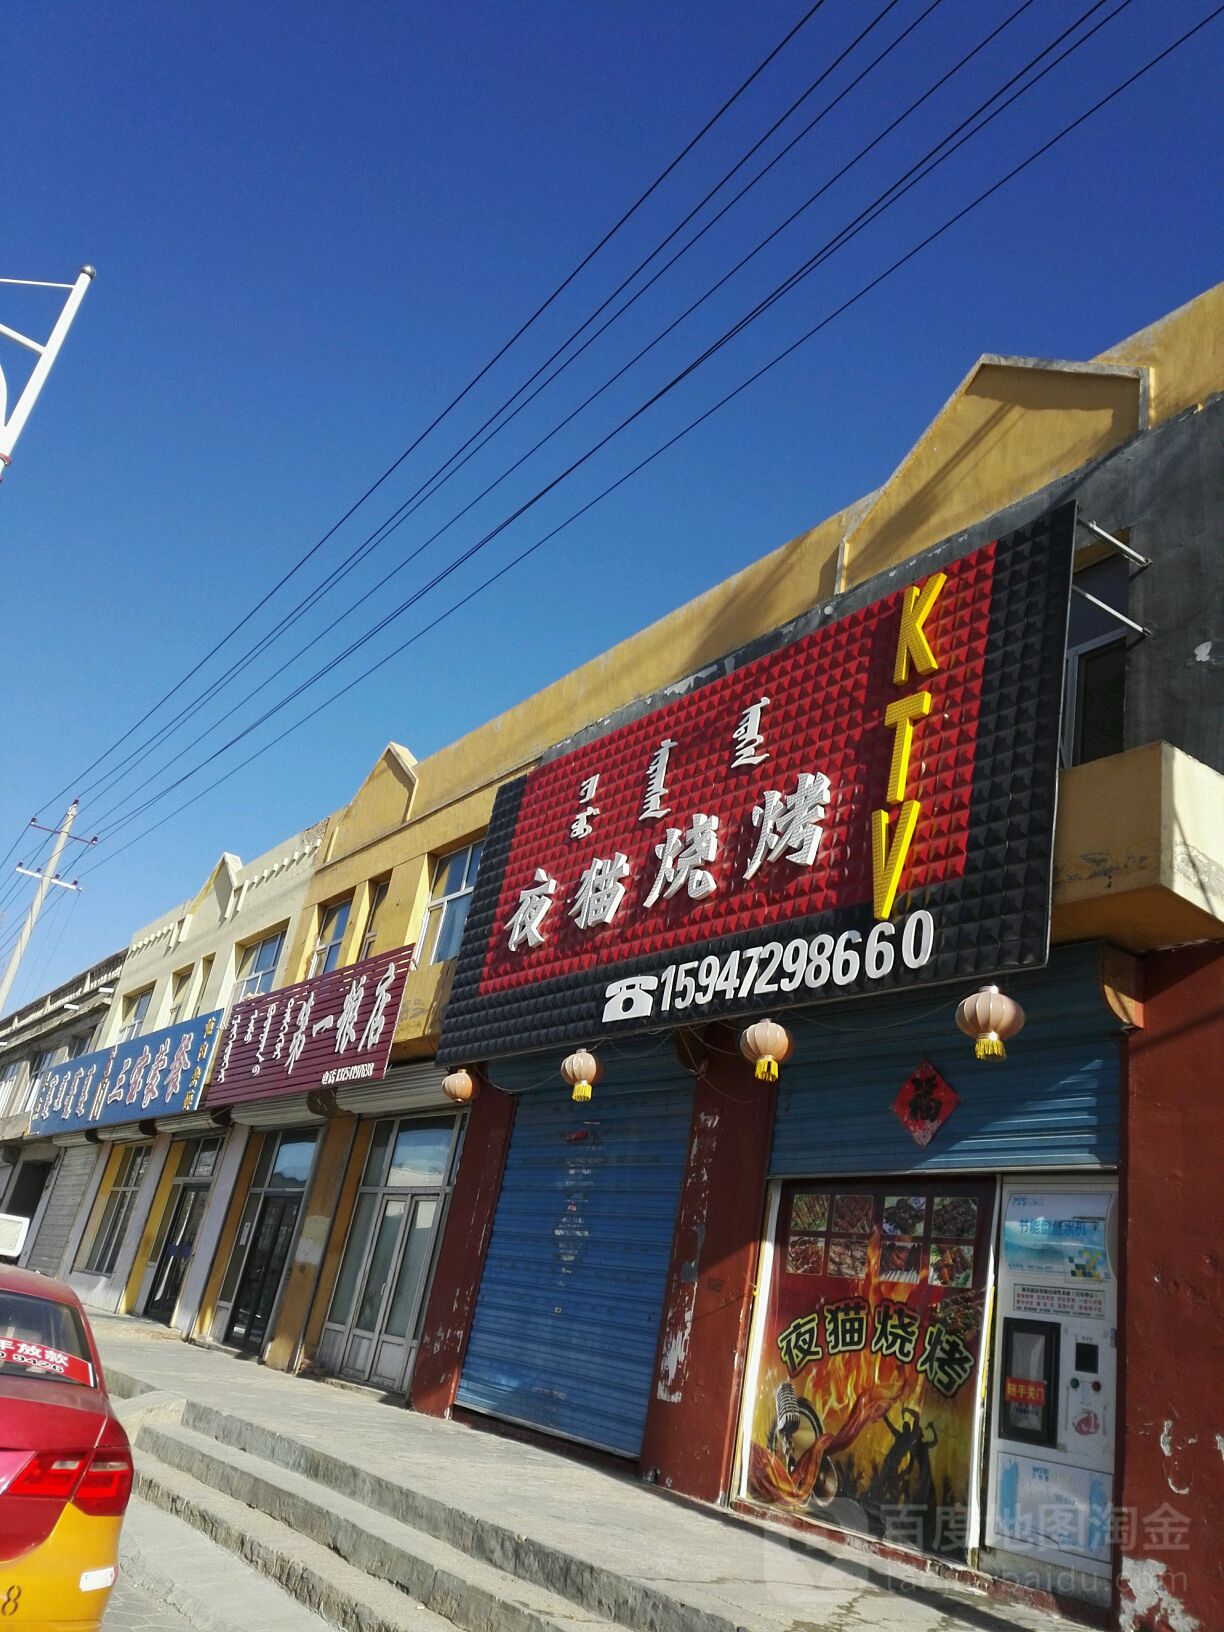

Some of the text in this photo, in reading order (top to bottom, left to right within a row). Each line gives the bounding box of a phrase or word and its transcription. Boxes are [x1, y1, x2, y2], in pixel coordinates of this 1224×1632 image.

[871, 572, 947, 920] KTV
[504, 772, 831, 951] 夜猫烧烤
[660, 909, 935, 1012] 15947298660
[777, 1298, 975, 1397] 夜猫烧烤
